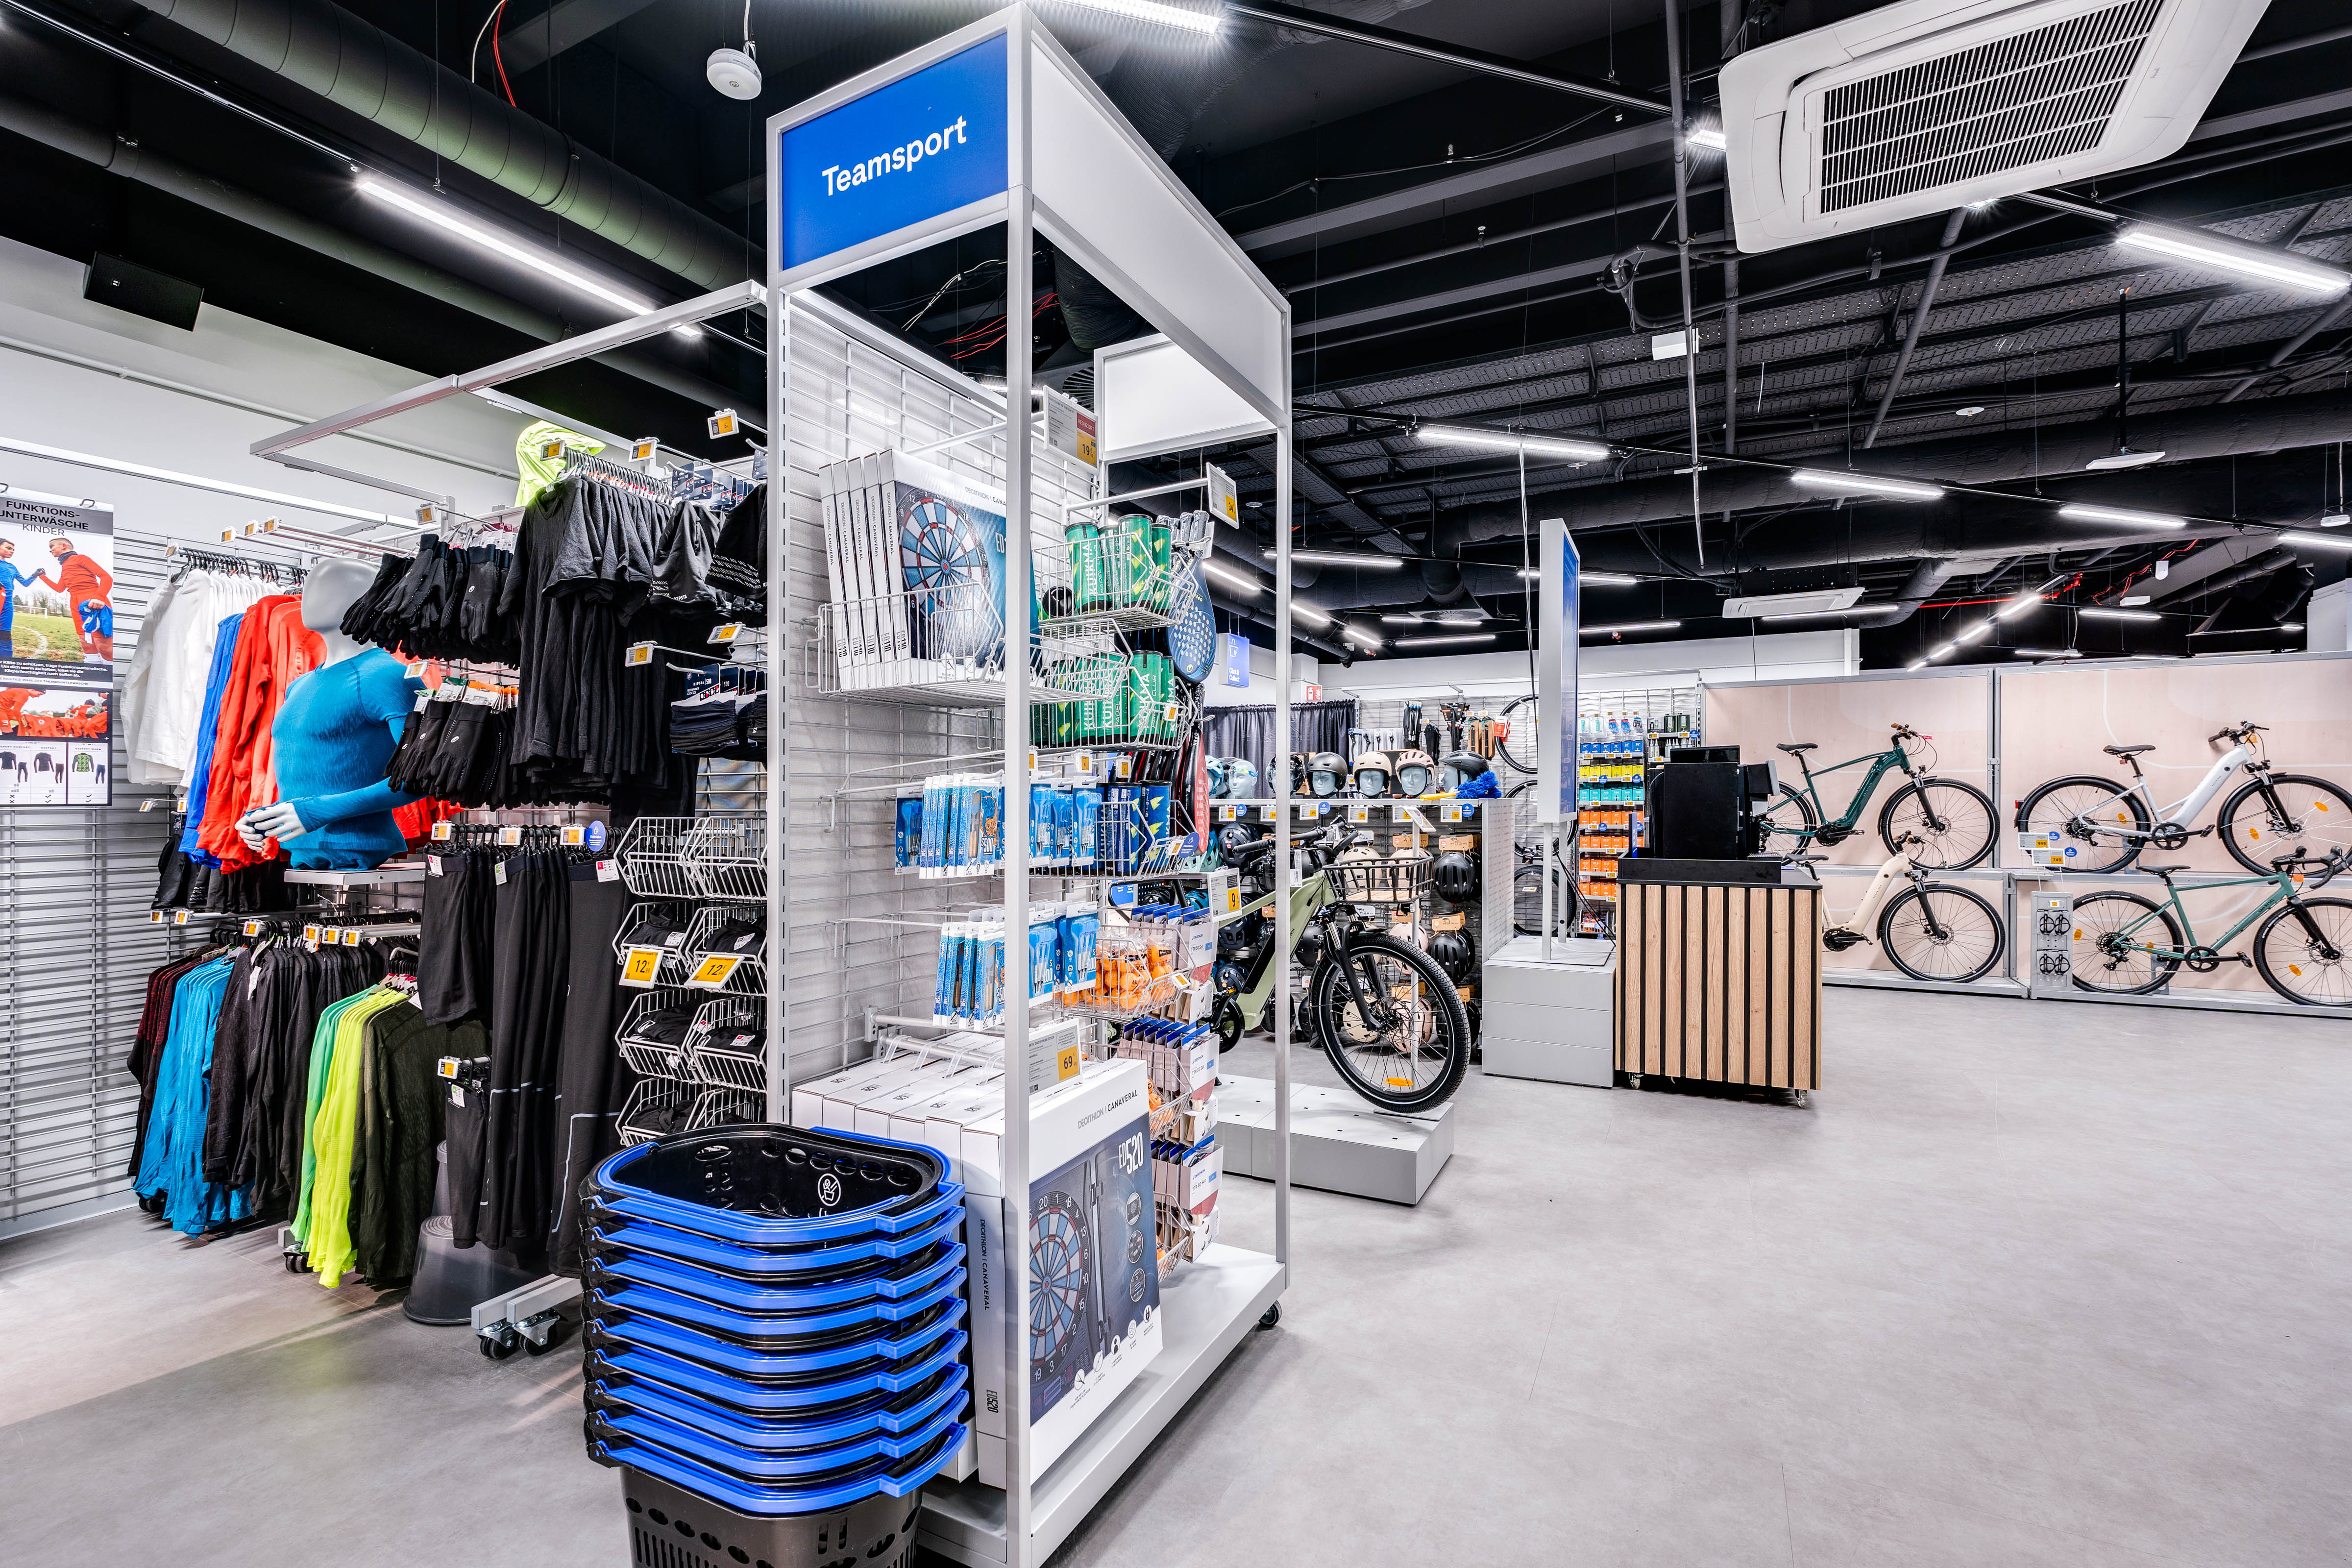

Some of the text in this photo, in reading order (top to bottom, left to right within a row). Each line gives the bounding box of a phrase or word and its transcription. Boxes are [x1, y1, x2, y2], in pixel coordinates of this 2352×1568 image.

[822, 115, 967, 196] Teamsport
[1078, 418, 1094, 432] REDUZIERT
[1082, 443, 1090, 455] 19
[909, 493, 915, 503] 12
[964, 487, 989, 499] DECATHLON
[6, 500, 80, 518] FUNKTIONS-
[963, 513, 969, 522] 18
[23, 523, 65, 536] KINDER
[981, 553, 987, 562] 13
[981, 837, 993, 853] S500
[1231, 892, 1236, 907] 9
[636, 959, 647, 973] 12
[707, 964, 723, 975] 12
[1064, 1055, 1073, 1070] 69
[1078, 1089, 1138, 1129] DECATHLON CANAVERAL
[1118, 1131, 1144, 1175] ED520
[1039, 1196, 1048, 1210] 20
[1055, 1193, 1058, 1204] 1
[1065, 1196, 1072, 1208] 18
[1075, 1209, 1079, 1219] 4
[1080, 1225, 1086, 1238] 13
[1084, 1249, 1088, 1259] 6
[1082, 1273, 1088, 1285] 10
[1078, 1298, 1084, 1311] 15
[1072, 1323, 1077, 1335] 2
[1061, 1343, 1067, 1357] 17
[1050, 1360, 1054, 1372] 3
[1034, 1368, 1042, 1382] 19
[986, 1389, 999, 1413] ED520
